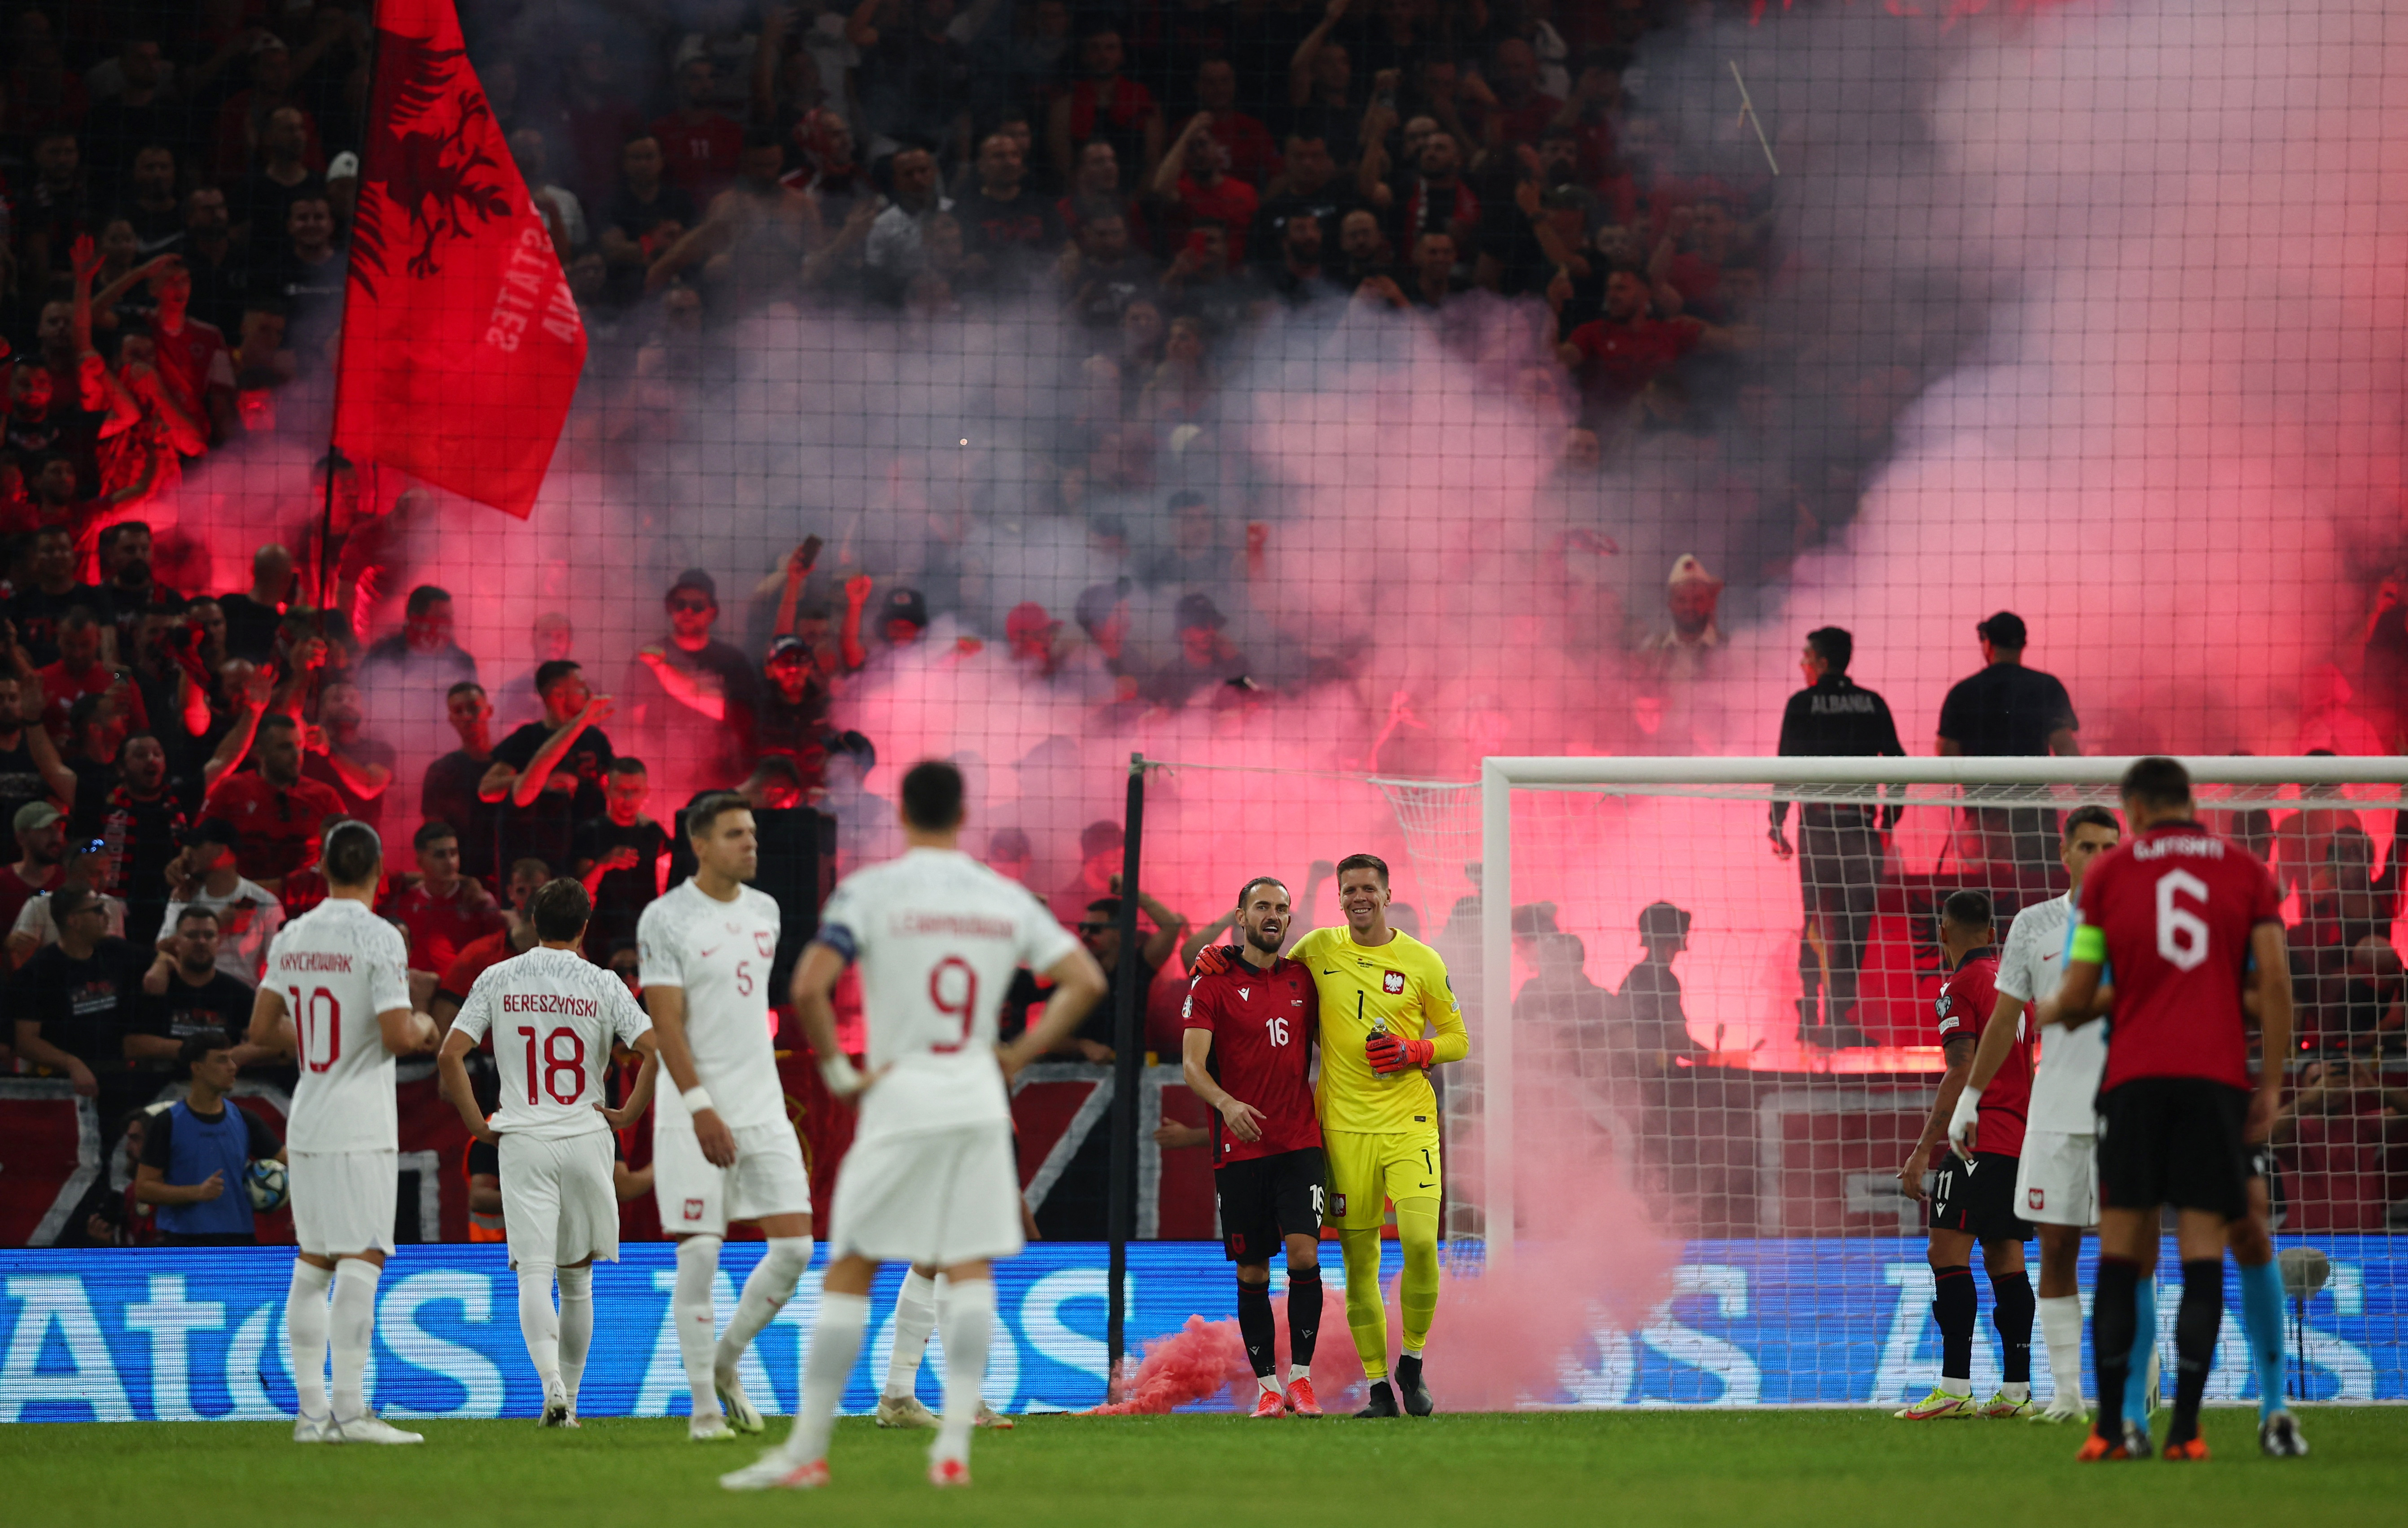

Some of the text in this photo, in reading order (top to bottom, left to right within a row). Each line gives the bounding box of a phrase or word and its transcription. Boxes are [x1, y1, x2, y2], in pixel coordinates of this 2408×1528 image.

[1811, 694, 1875, 714] ALBANIA
[2156, 868, 2209, 972] 6
[736, 960, 753, 997] 5
[503, 994, 598, 1017] BERESZYŃSKI
[928, 954, 979, 1055] 9
[1357, 990, 1364, 1019] 1
[288, 985, 341, 1074] 10
[1265, 1017, 1289, 1048] 16
[518, 1026, 586, 1105] 18
[1421, 1148, 1433, 1175] 1
[1309, 1183, 1324, 1214] 16
[1937, 1170, 1953, 1201] 11
